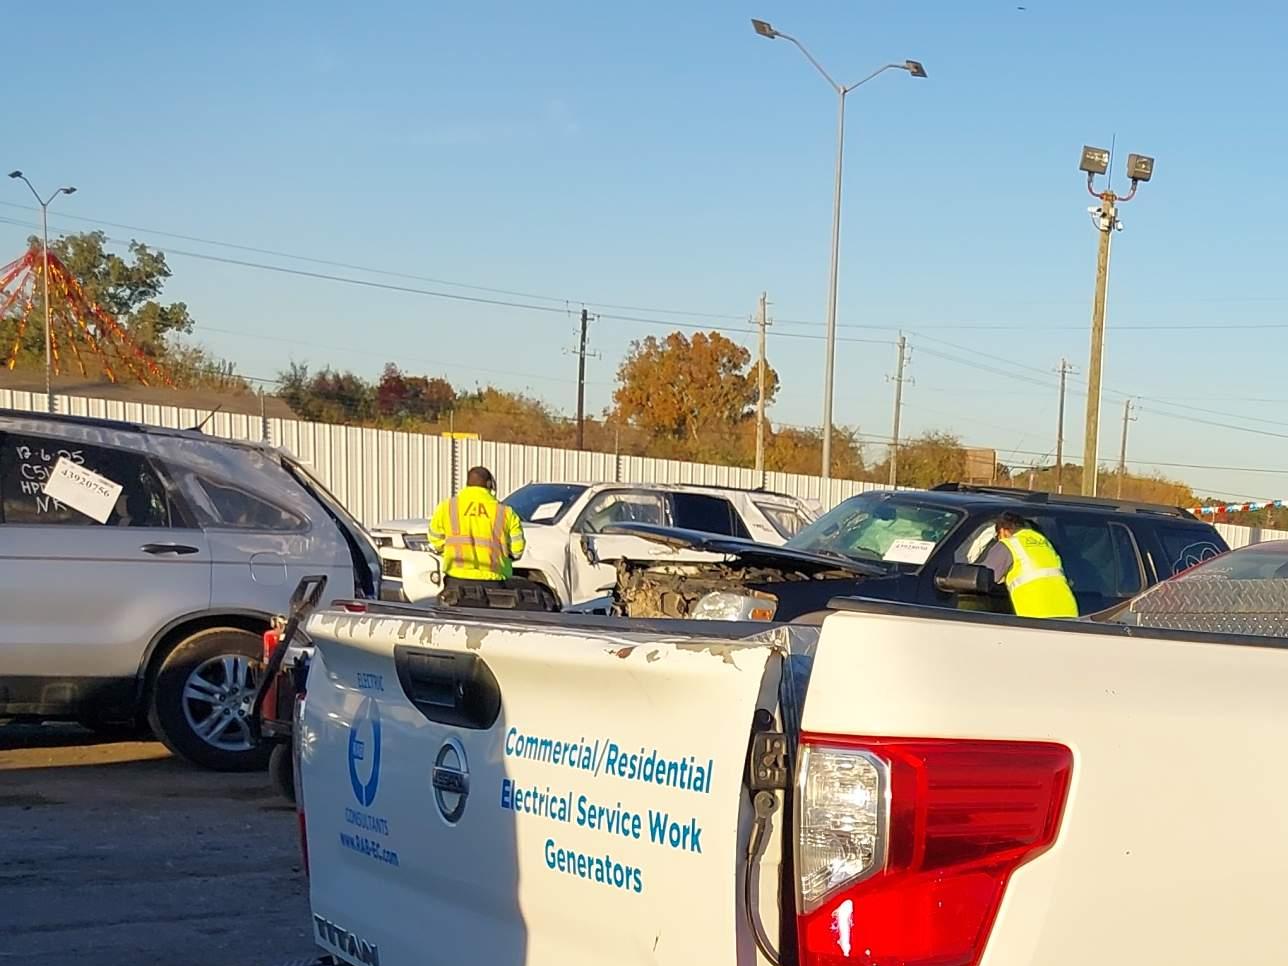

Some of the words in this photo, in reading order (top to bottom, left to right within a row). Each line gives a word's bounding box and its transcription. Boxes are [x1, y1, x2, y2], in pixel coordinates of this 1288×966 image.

[61, 468, 110, 498] 43920756
[357, 672, 385, 692] ELECTRIC
[504, 726, 714, 795] Commercial/Residential
[344, 807, 390, 836] CONSULTANTS
[501, 778, 573, 823] Electrical
[576, 795, 642, 840] Service
[648, 809, 703, 854] Work
[545, 838, 643, 893] Generators
